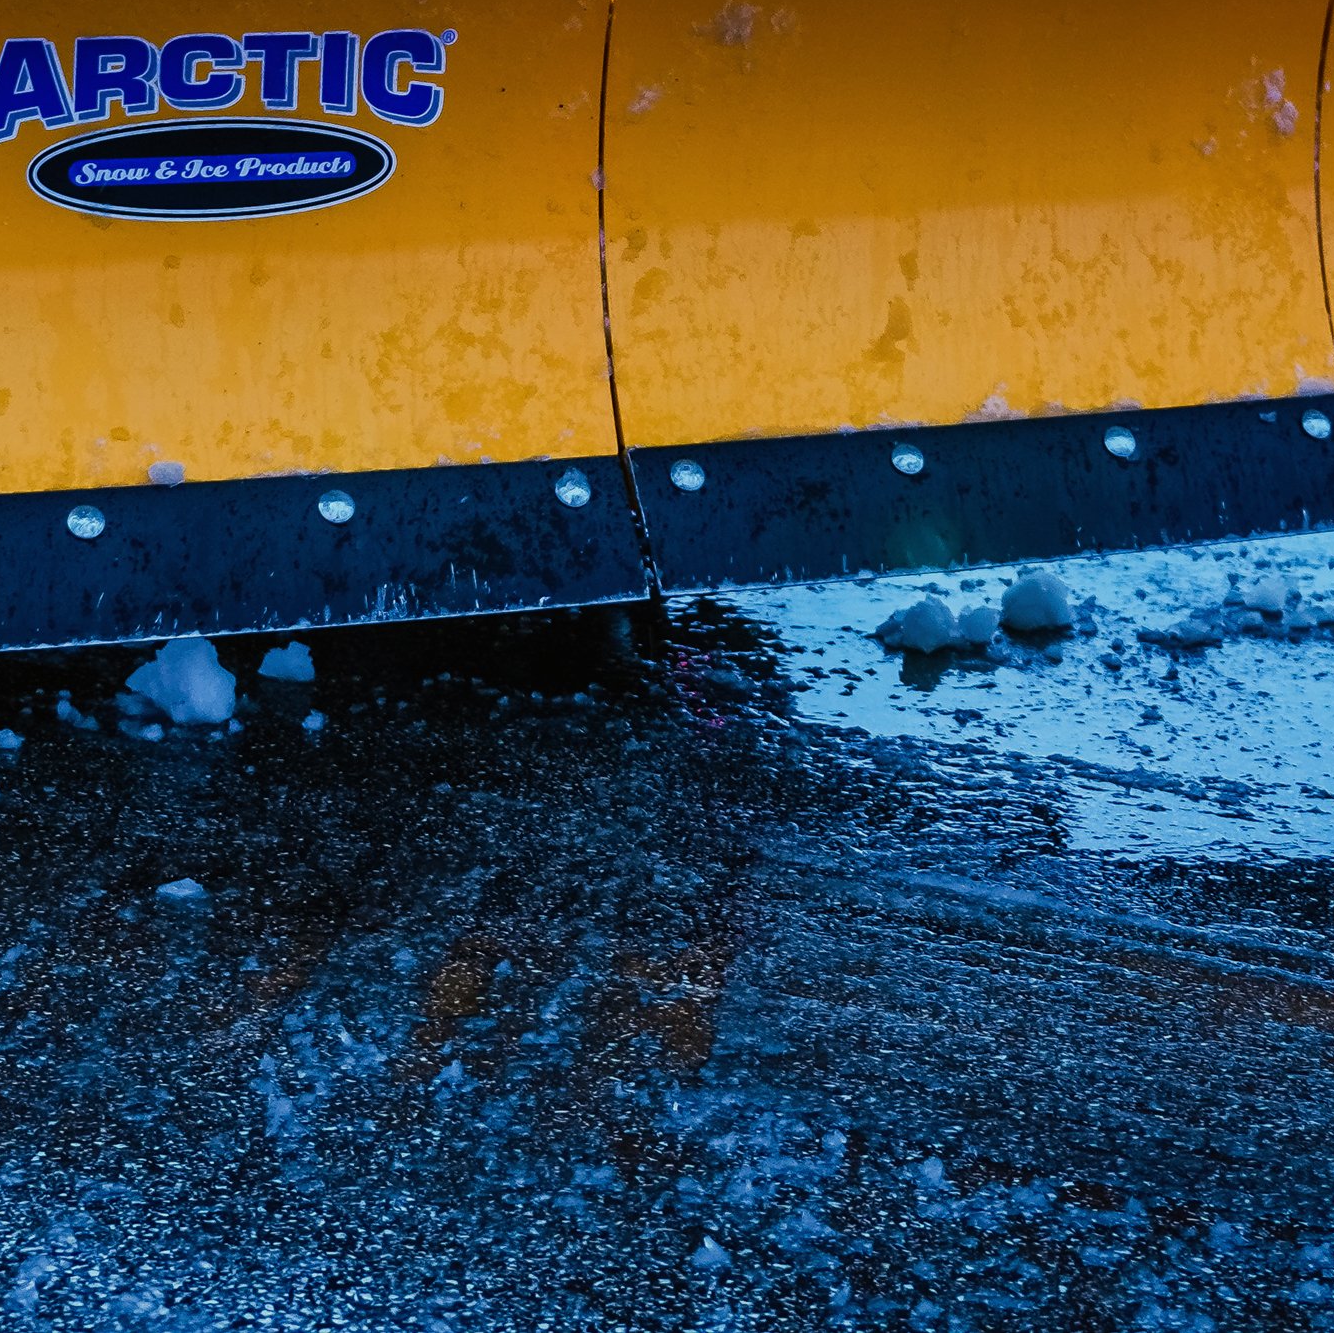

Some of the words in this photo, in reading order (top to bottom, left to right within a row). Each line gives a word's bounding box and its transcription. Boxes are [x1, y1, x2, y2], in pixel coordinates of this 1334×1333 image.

[75, 162, 151, 184] Snow
[155, 160, 177, 180] &
[181, 159, 229, 179] Ice
[235, 155, 352, 178] Products
